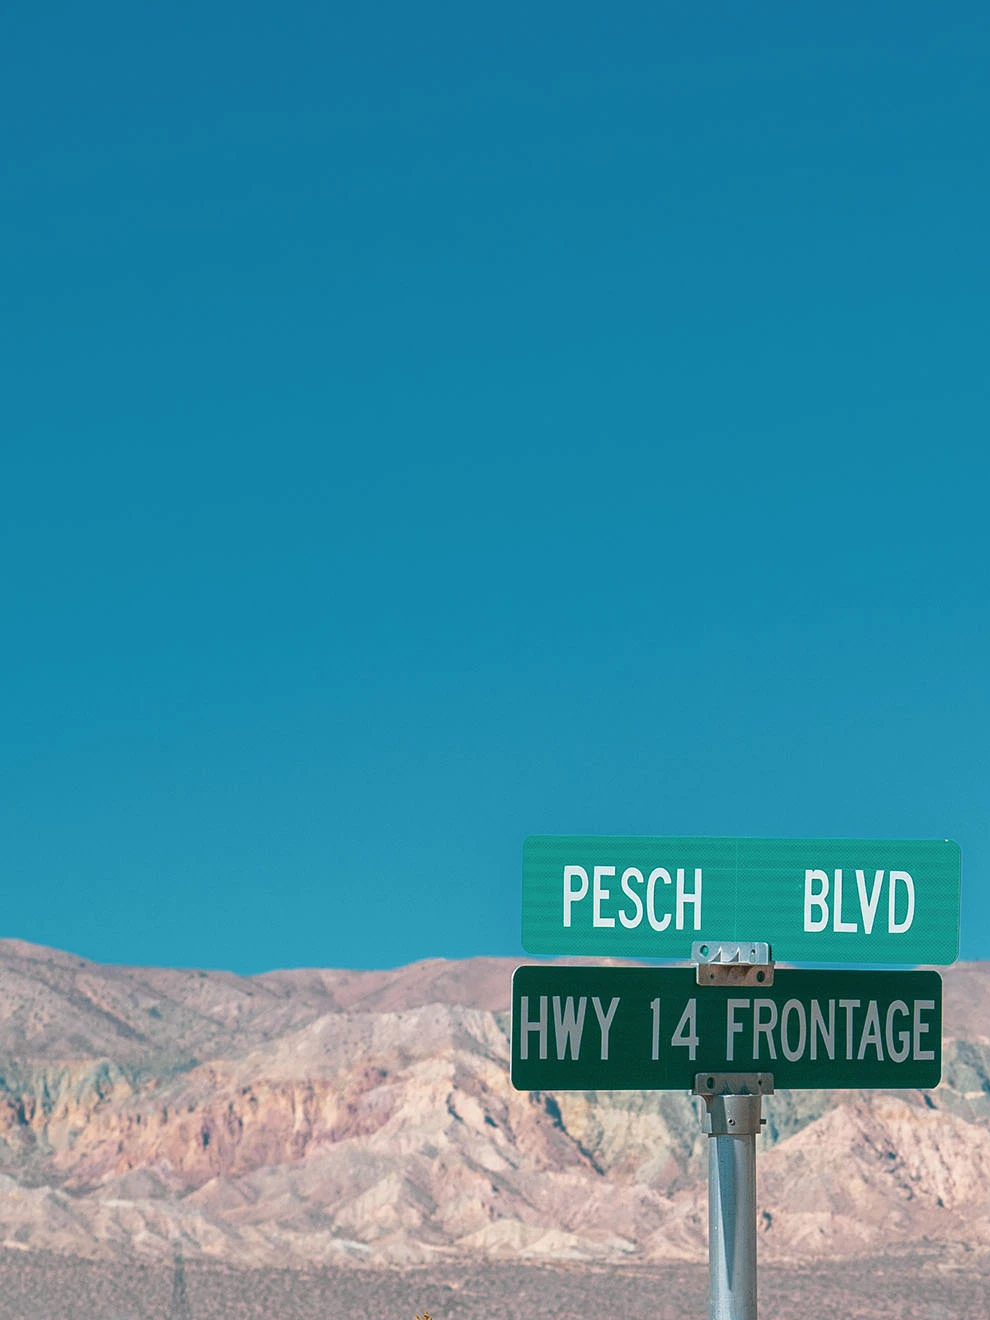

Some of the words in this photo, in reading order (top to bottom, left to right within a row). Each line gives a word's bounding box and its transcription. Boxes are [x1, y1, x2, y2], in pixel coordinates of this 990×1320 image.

[563, 865, 702, 932] PESCH
[804, 868, 915, 934] BLVD
[520, 996, 620, 1060] HWY
[650, 998, 699, 1061] 14
[726, 998, 936, 1063] FRONTAGE
